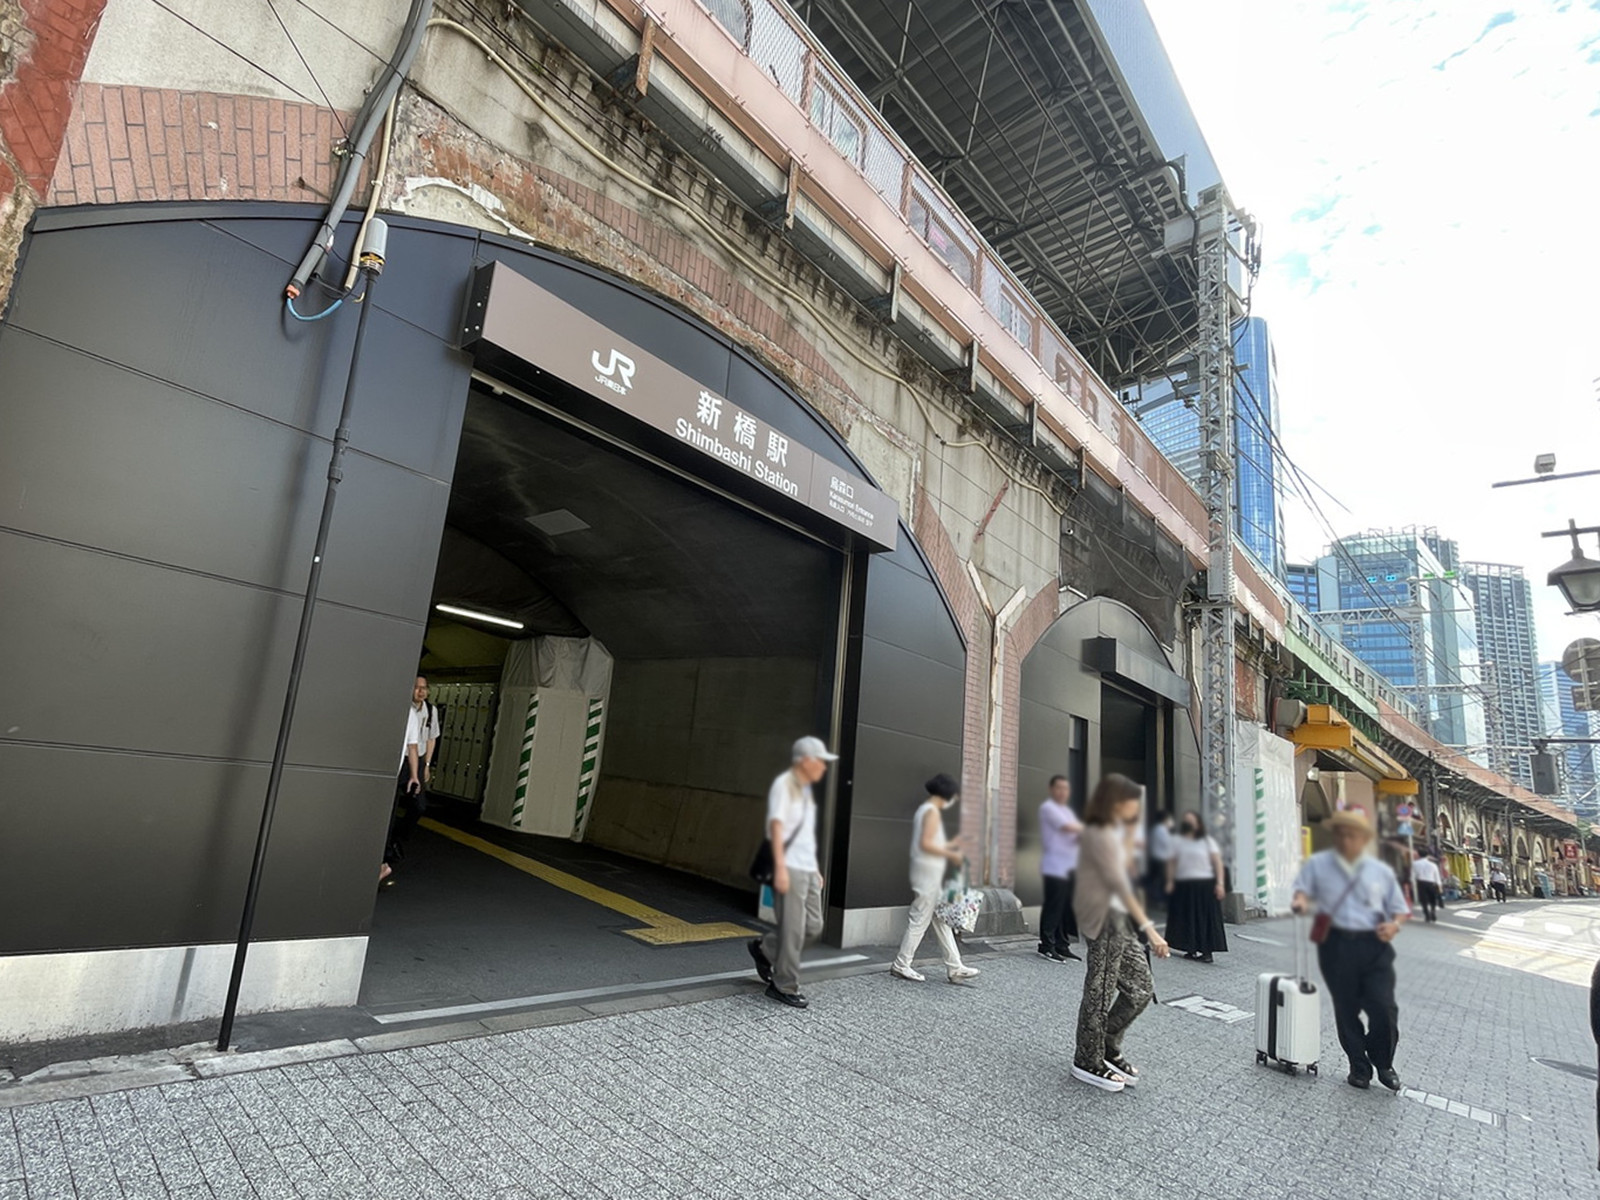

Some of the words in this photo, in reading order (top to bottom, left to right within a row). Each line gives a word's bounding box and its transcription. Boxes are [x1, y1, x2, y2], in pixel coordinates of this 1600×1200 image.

[592, 349, 636, 389] JR
[675, 418, 752, 472] Shimbashi
[754, 460, 799, 497] Station
[697, 390, 789, 467] 新橋駅
